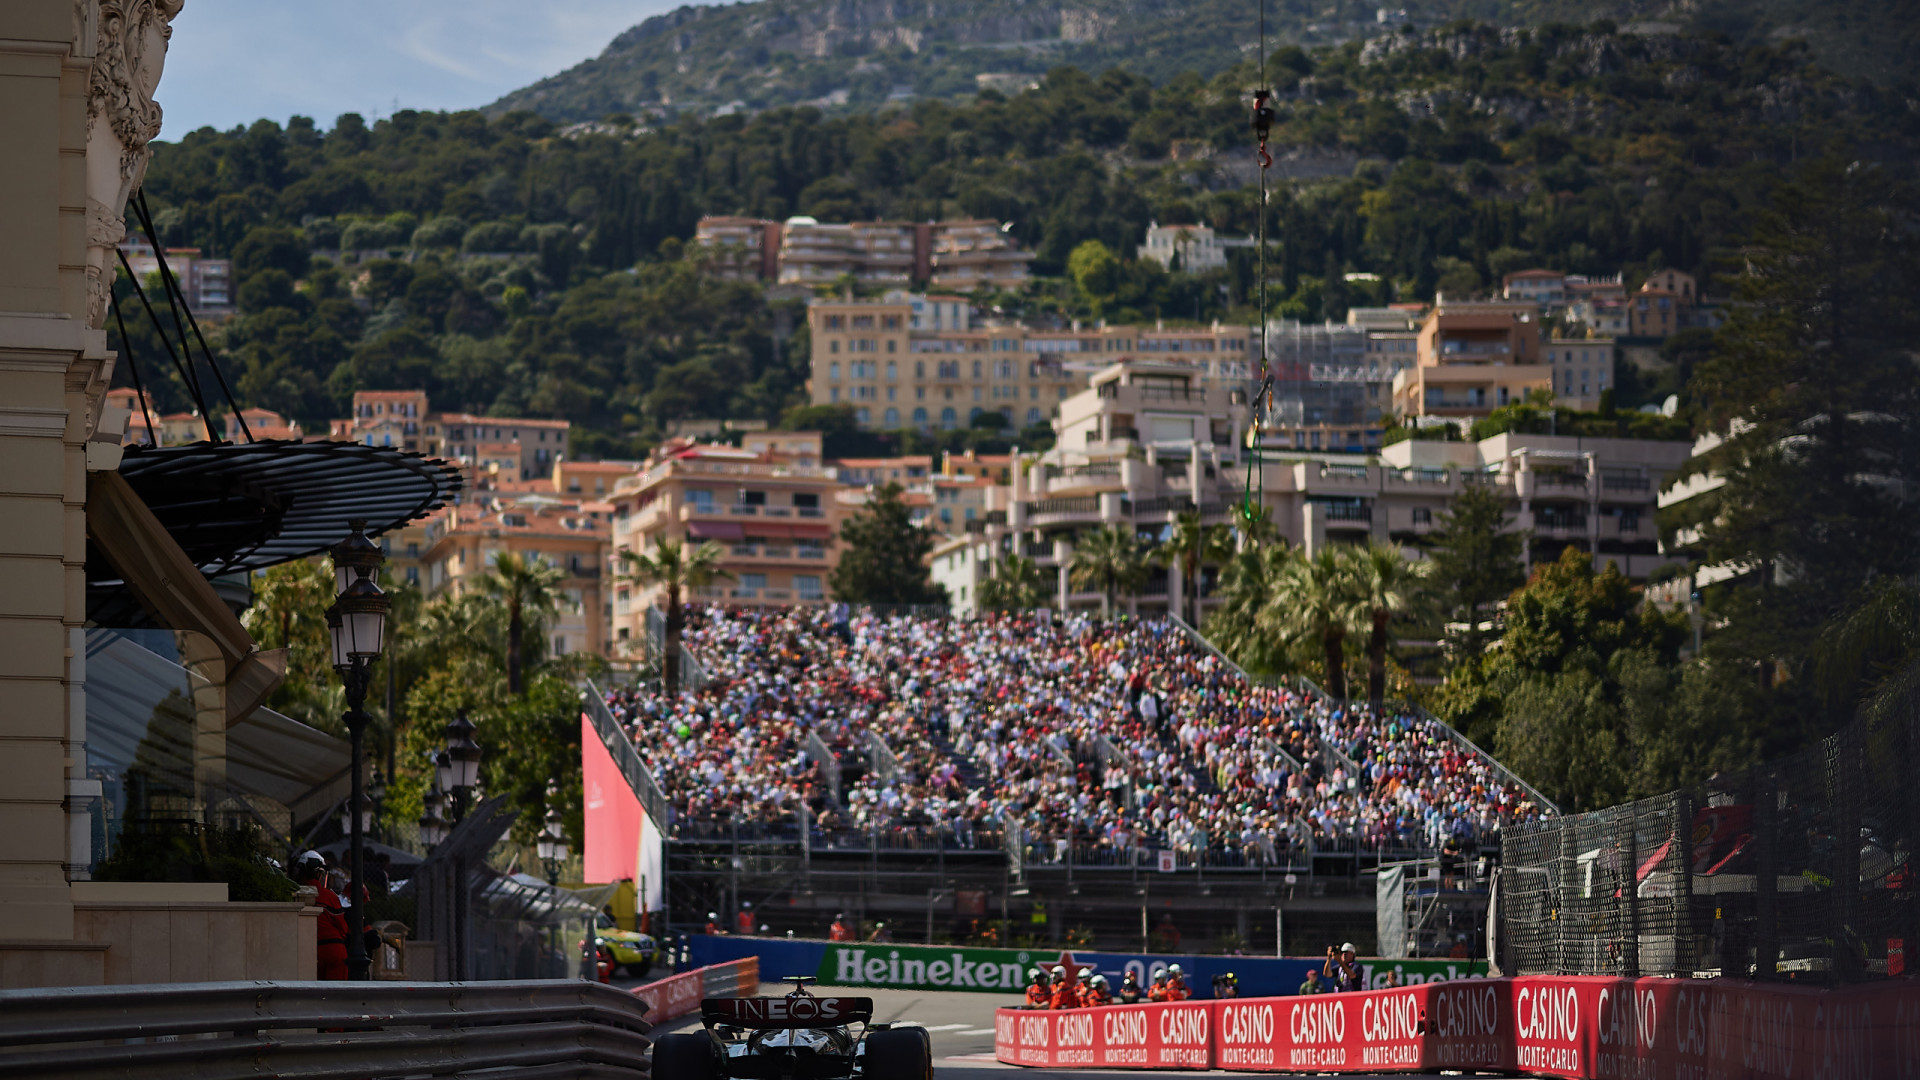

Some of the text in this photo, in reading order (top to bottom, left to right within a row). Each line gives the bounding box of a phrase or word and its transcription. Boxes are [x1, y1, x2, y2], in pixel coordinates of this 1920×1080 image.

[834, 948, 1026, 989] Heineken
[734, 999, 840, 1020] INEOS
[1056, 1014, 1094, 1046] CASINO
[1104, 1010, 1147, 1045] CASINO
[1160, 1008, 1208, 1045] CASINO
[1223, 1004, 1274, 1044] CASINO
[1290, 1000, 1345, 1044] CASINO
[1362, 993, 1418, 1042] CASINO
[1437, 986, 1497, 1038] CASINO
[1517, 985, 1578, 1042] CASINO
[1598, 986, 1656, 1049] CASINO
[1676, 989, 1728, 1060] CASNO
[1019, 1015, 1049, 1047] CASINO
